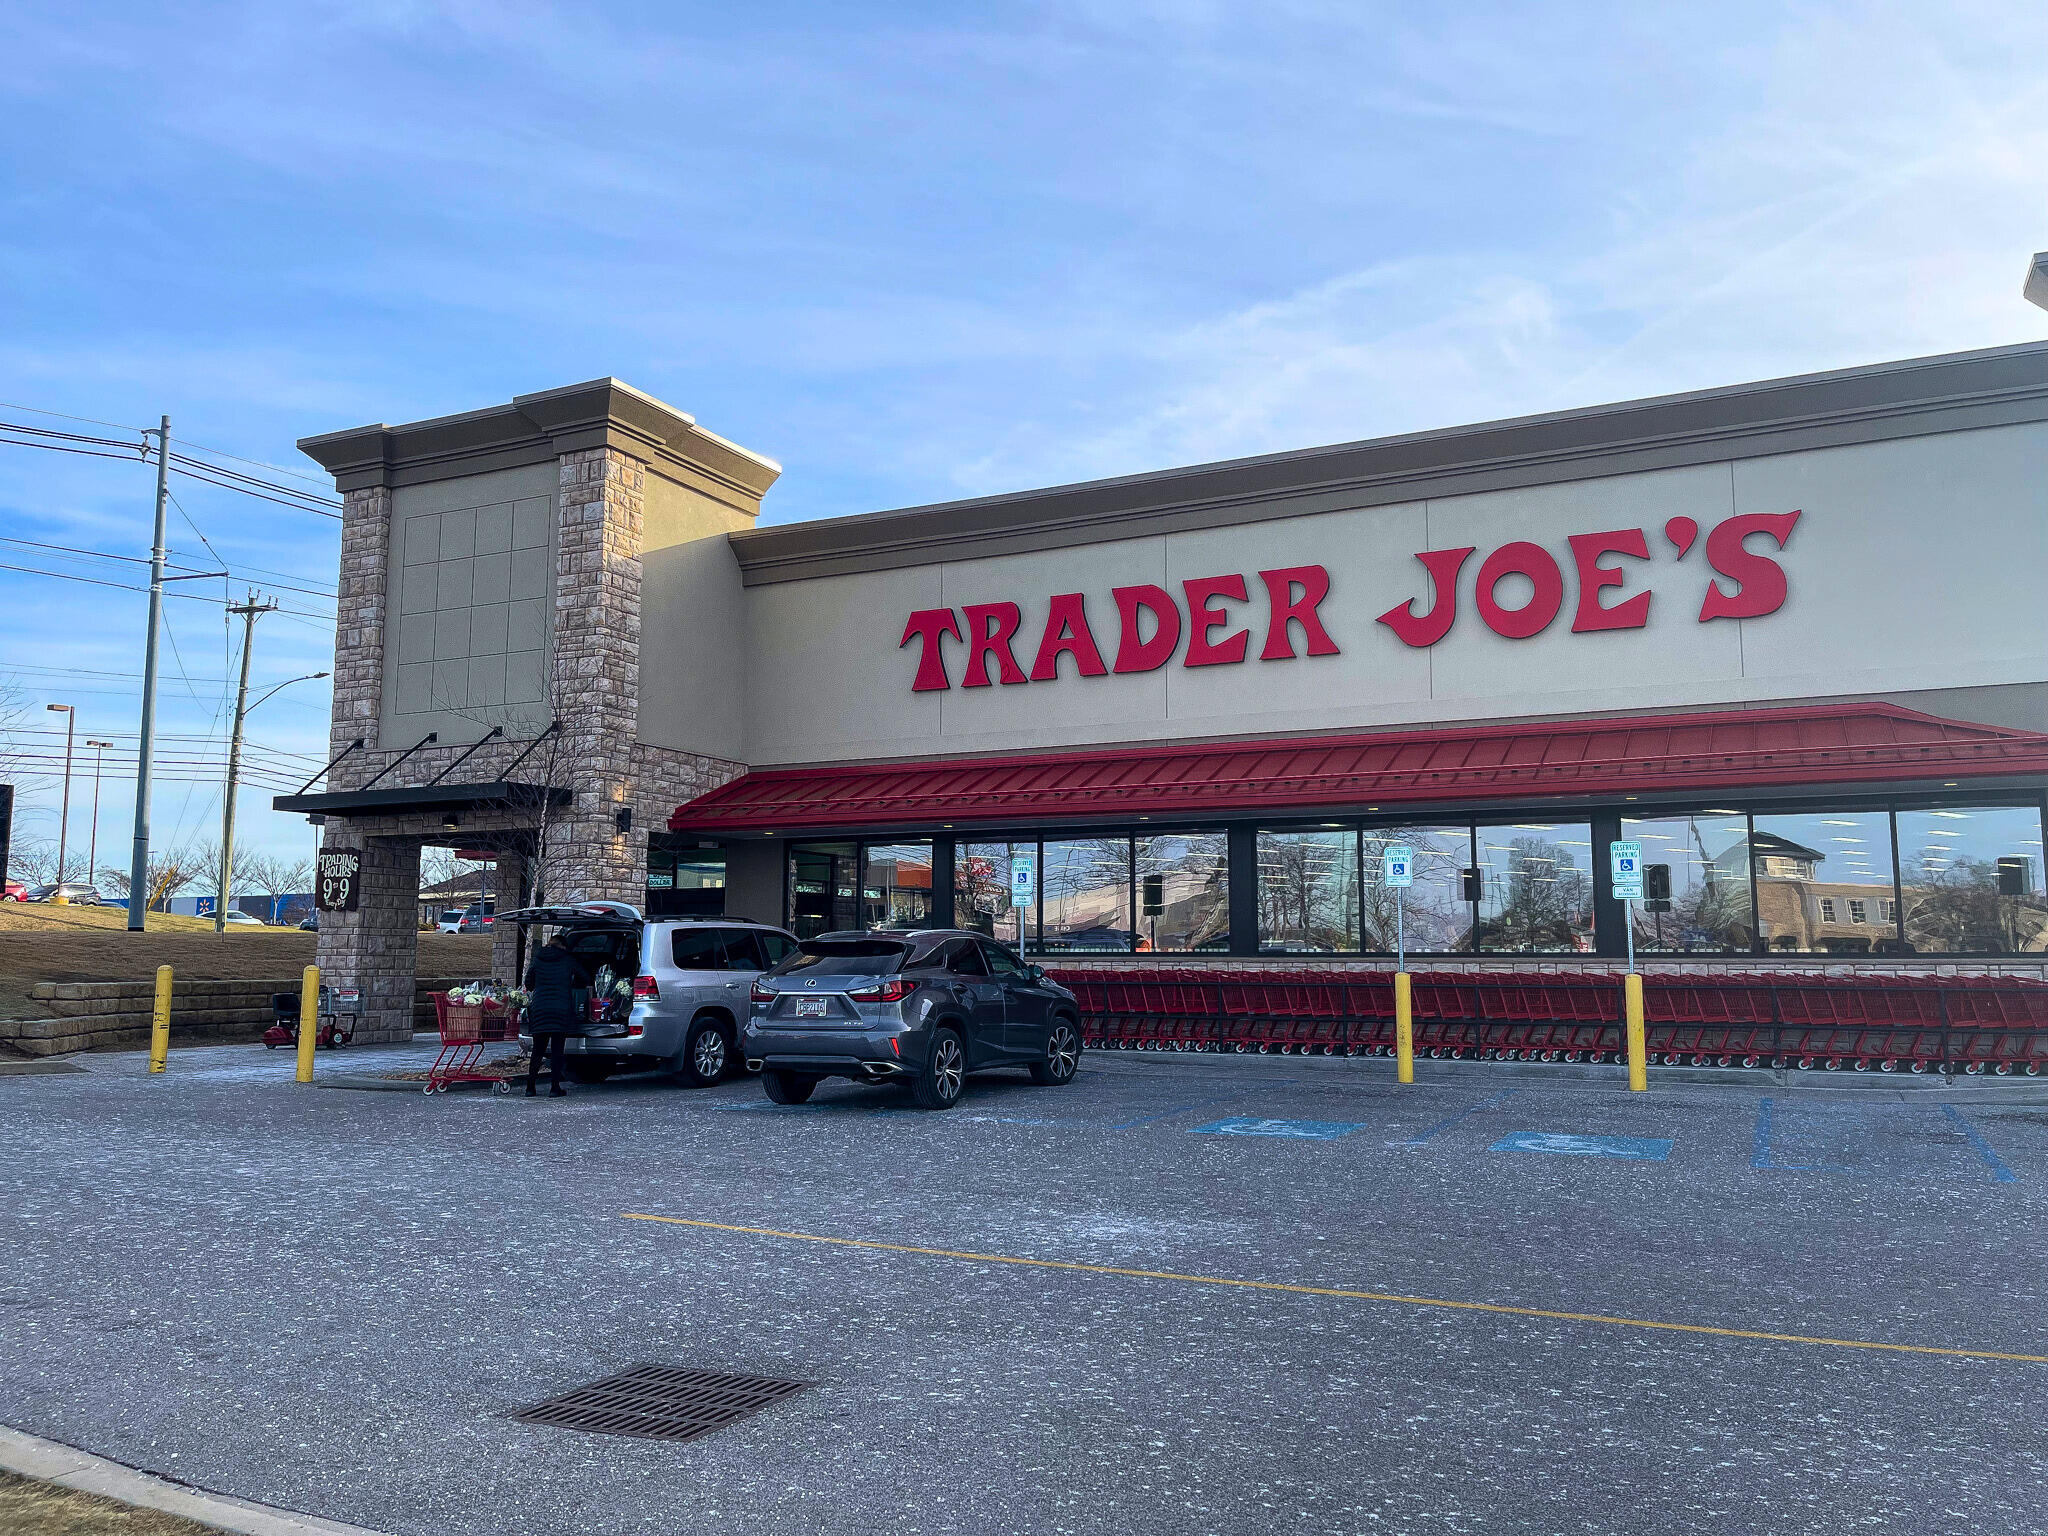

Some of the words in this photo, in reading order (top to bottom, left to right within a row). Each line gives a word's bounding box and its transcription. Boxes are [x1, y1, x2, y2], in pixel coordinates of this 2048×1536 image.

[899, 564, 1342, 692] TRADER
[1374, 509, 1802, 648] JOE'S
[319, 854, 359, 872] TRADING
[323, 865, 352, 878] HOURS
[323, 878, 333, 899] 9
[340, 878, 350, 899] 9
